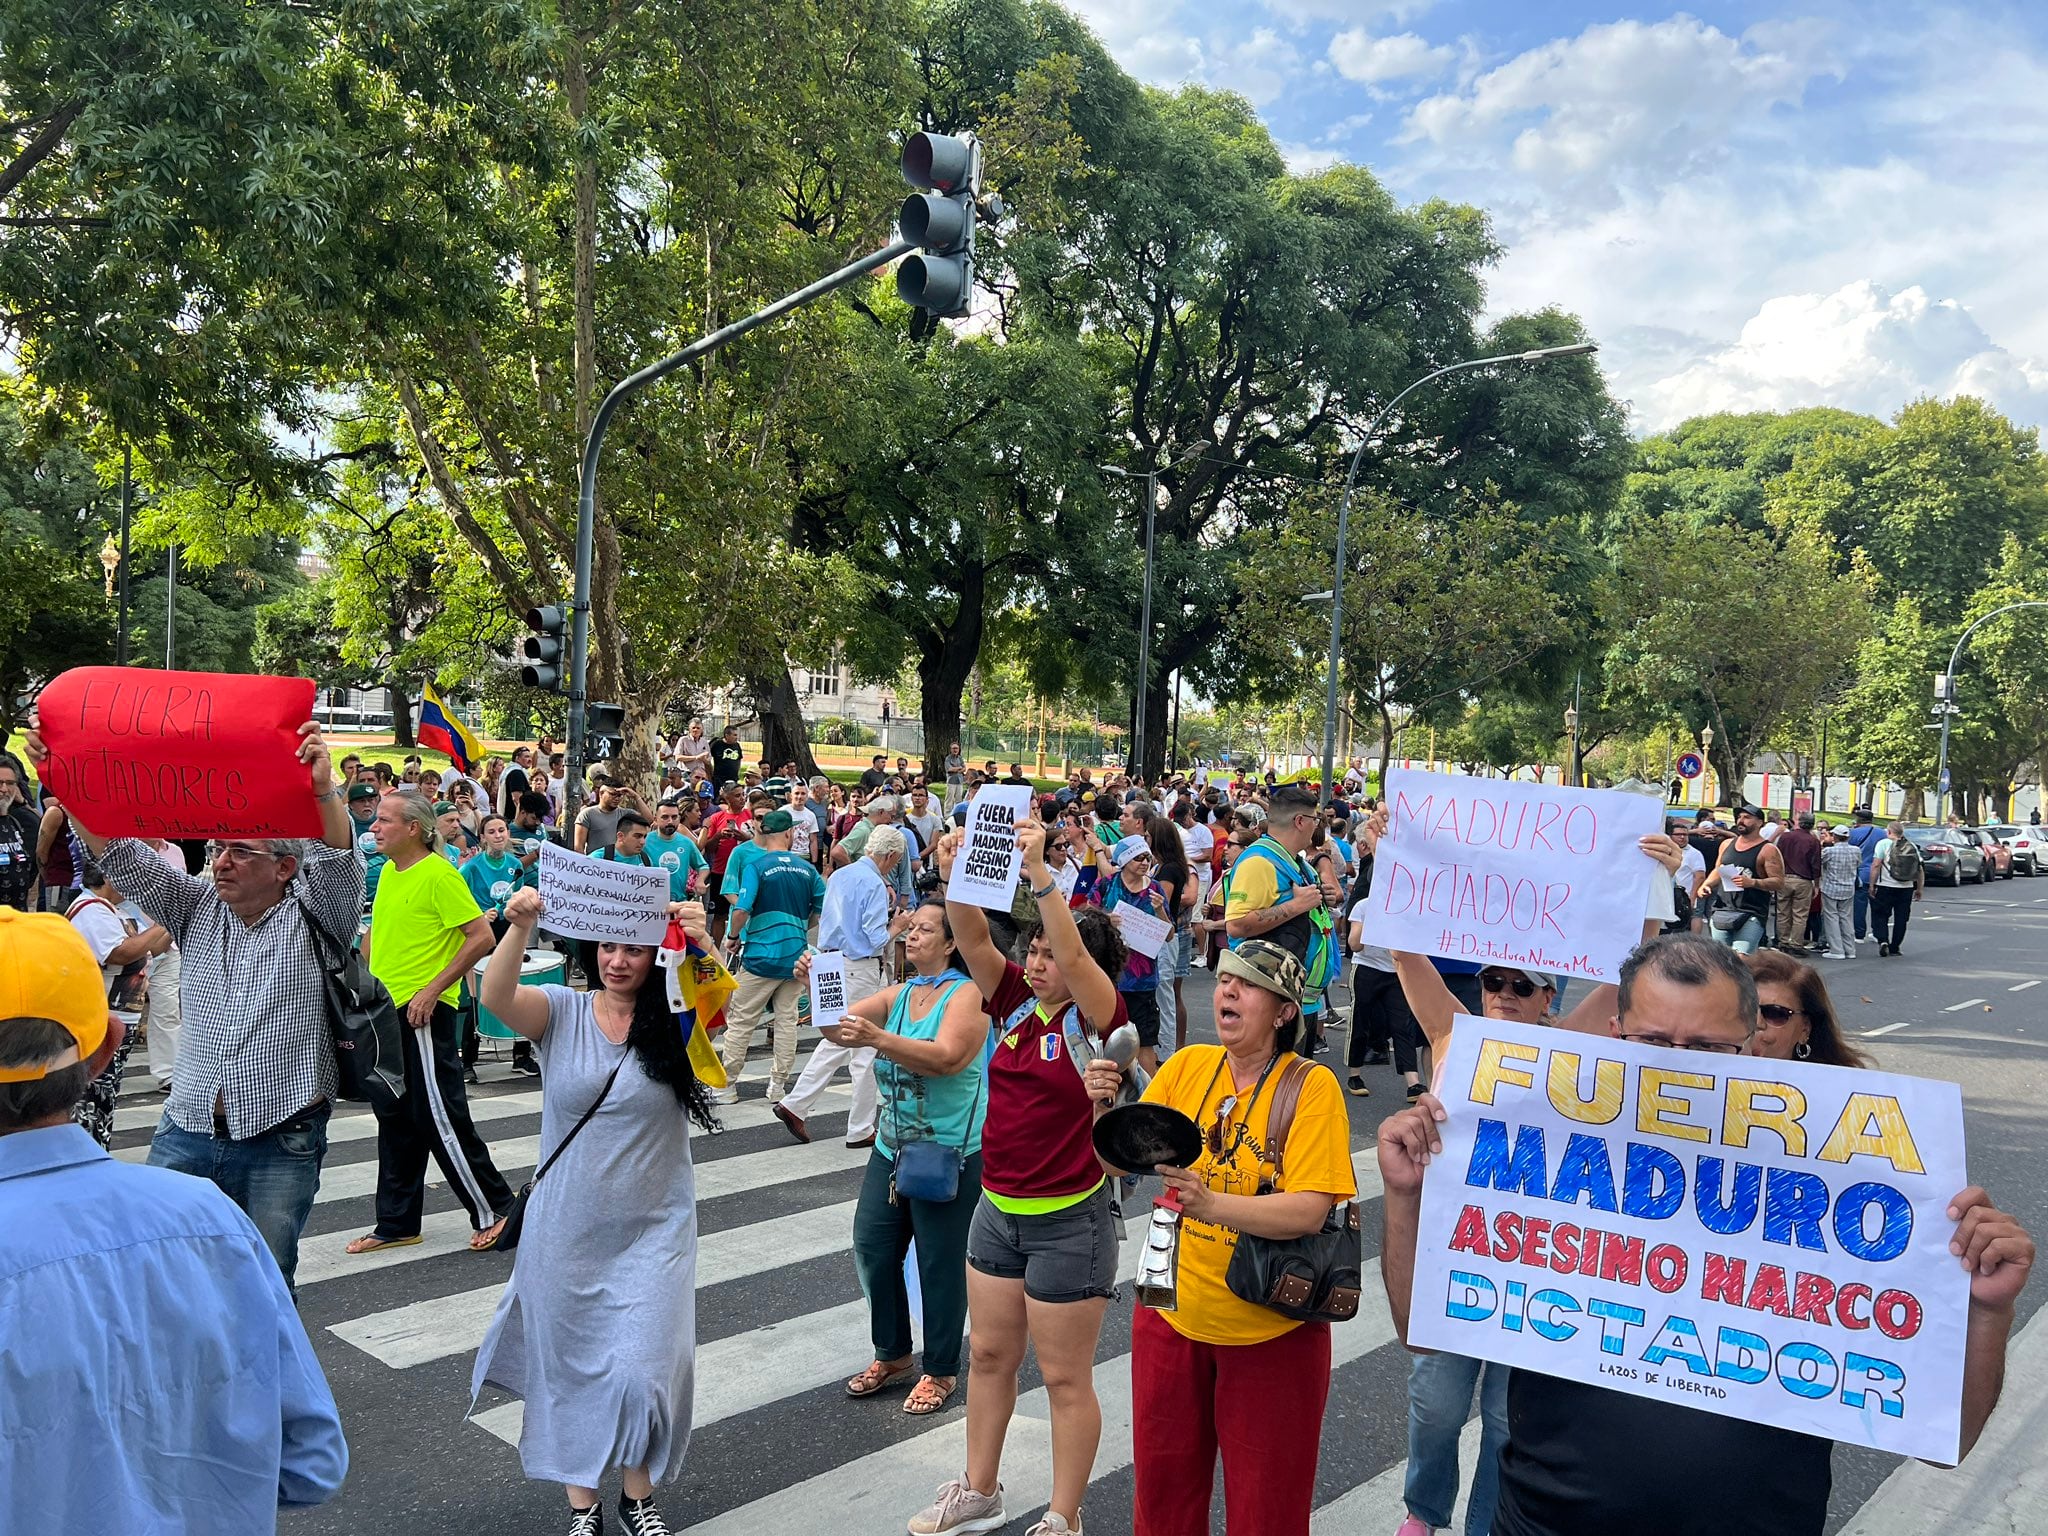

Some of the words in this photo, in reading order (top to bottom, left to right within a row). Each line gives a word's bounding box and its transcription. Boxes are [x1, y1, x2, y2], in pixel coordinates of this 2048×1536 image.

[80, 679, 215, 742] FUERA
[48, 747, 249, 811] DICTADORES
[975, 821, 983, 832] DE
[977, 803, 1014, 826] FUERA
[1393, 790, 1597, 855] MADURO
[967, 848, 1012, 869] ASESINO
[972, 833, 1014, 853] MADURO
[965, 862, 1008, 882] DICTADOR
[1384, 861, 1571, 940] DICTADOR
[1436, 928, 1605, 977] #DictaduraNuncaMas
[818, 971, 841, 983] FUERA
[819, 987, 843, 996] MADURO
[820, 994, 844, 1003] ASESINO
[1468, 1037, 1928, 1176] FUERA
[1464, 1117, 1914, 1263] MADURO
[1448, 1203, 1690, 1295] ASESINO
[1700, 1251, 1924, 1341] NARCO
[1445, 1269, 1906, 1419] DICTADOR
[1599, 1362, 1638, 1381] LAZOS
[1645, 1371, 1659, 1385] DE
[1665, 1375, 1728, 1400] LIBERTAD
